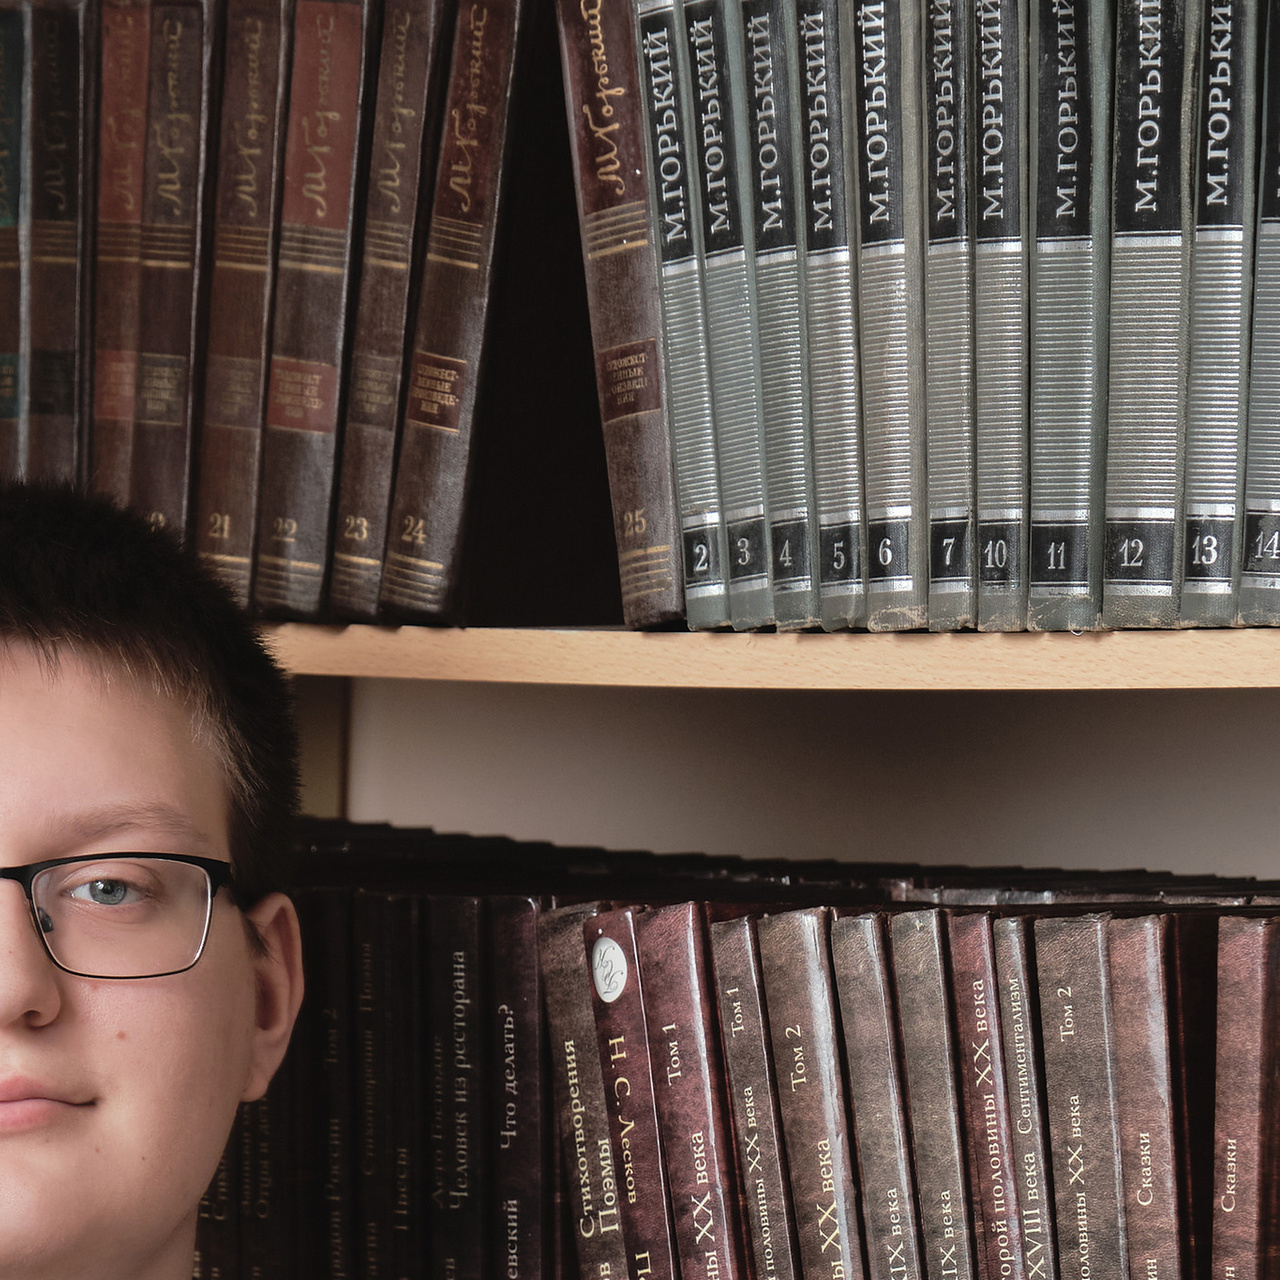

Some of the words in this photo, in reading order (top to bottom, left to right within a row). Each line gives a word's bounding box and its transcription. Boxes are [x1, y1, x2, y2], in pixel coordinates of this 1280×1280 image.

[208, 513, 231, 540] 21
[342, 514, 369, 541] 23
[401, 515, 427, 544] 24
[624, 507, 646, 537] 25
[693, 544, 709, 572] 2
[737, 538, 751, 565] 3
[779, 540, 792, 567] 4
[834, 541, 845, 570] 5
[878, 538, 893, 566] 6
[942, 538, 955, 566] 7
[983, 539, 1008, 569] 10
[1047, 541, 1066, 570] 11
[1119, 538, 1144, 568] 12
[1191, 535, 1219, 565] 13
[1254, 530, 1280, 561] 14
[452, 950, 472, 1070] ресторана
[726, 987, 739, 996] 1
[972, 979, 988, 1033] века
[1057, 986, 1072, 998] 2
[661, 1022, 676, 1034] 1
[731, 1001, 744, 1038] Том
[785, 1024, 801, 1039] 2
[1060, 1004, 1074, 1042] Том
[498, 1003, 519, 1095] делать?
[608, 1036, 626, 1069] Н.
[667, 1040, 681, 1086] Том
[1009, 978, 1032, 1135] Сентиментализм
[790, 1046, 807, 1092] Том
[455, 1075, 468, 1102] из
[614, 1077, 630, 1106] С.
[744, 1086, 758, 1128] века
[500, 1102, 517, 1149] Что
[1069, 1094, 1082, 1138] века
[564, 1040, 595, 1238] Стихотворения
[691, 1130, 709, 1184] века
[983, 1093, 1005, 1213] половины
[449, 1111, 469, 1209] Человек
[618, 1115, 637, 1204] Лесков
[817, 1138, 835, 1193] века
[1023, 1152, 1039, 1201] века
[1136, 1132, 1153, 1206] Сказки
[1221, 1139, 1237, 1213] Сказки
[597, 1138, 619, 1233] Поэмы
[756, 1179, 775, 1271] половины
[887, 1187, 902, 1236] века
[940, 1190, 955, 1239] века
